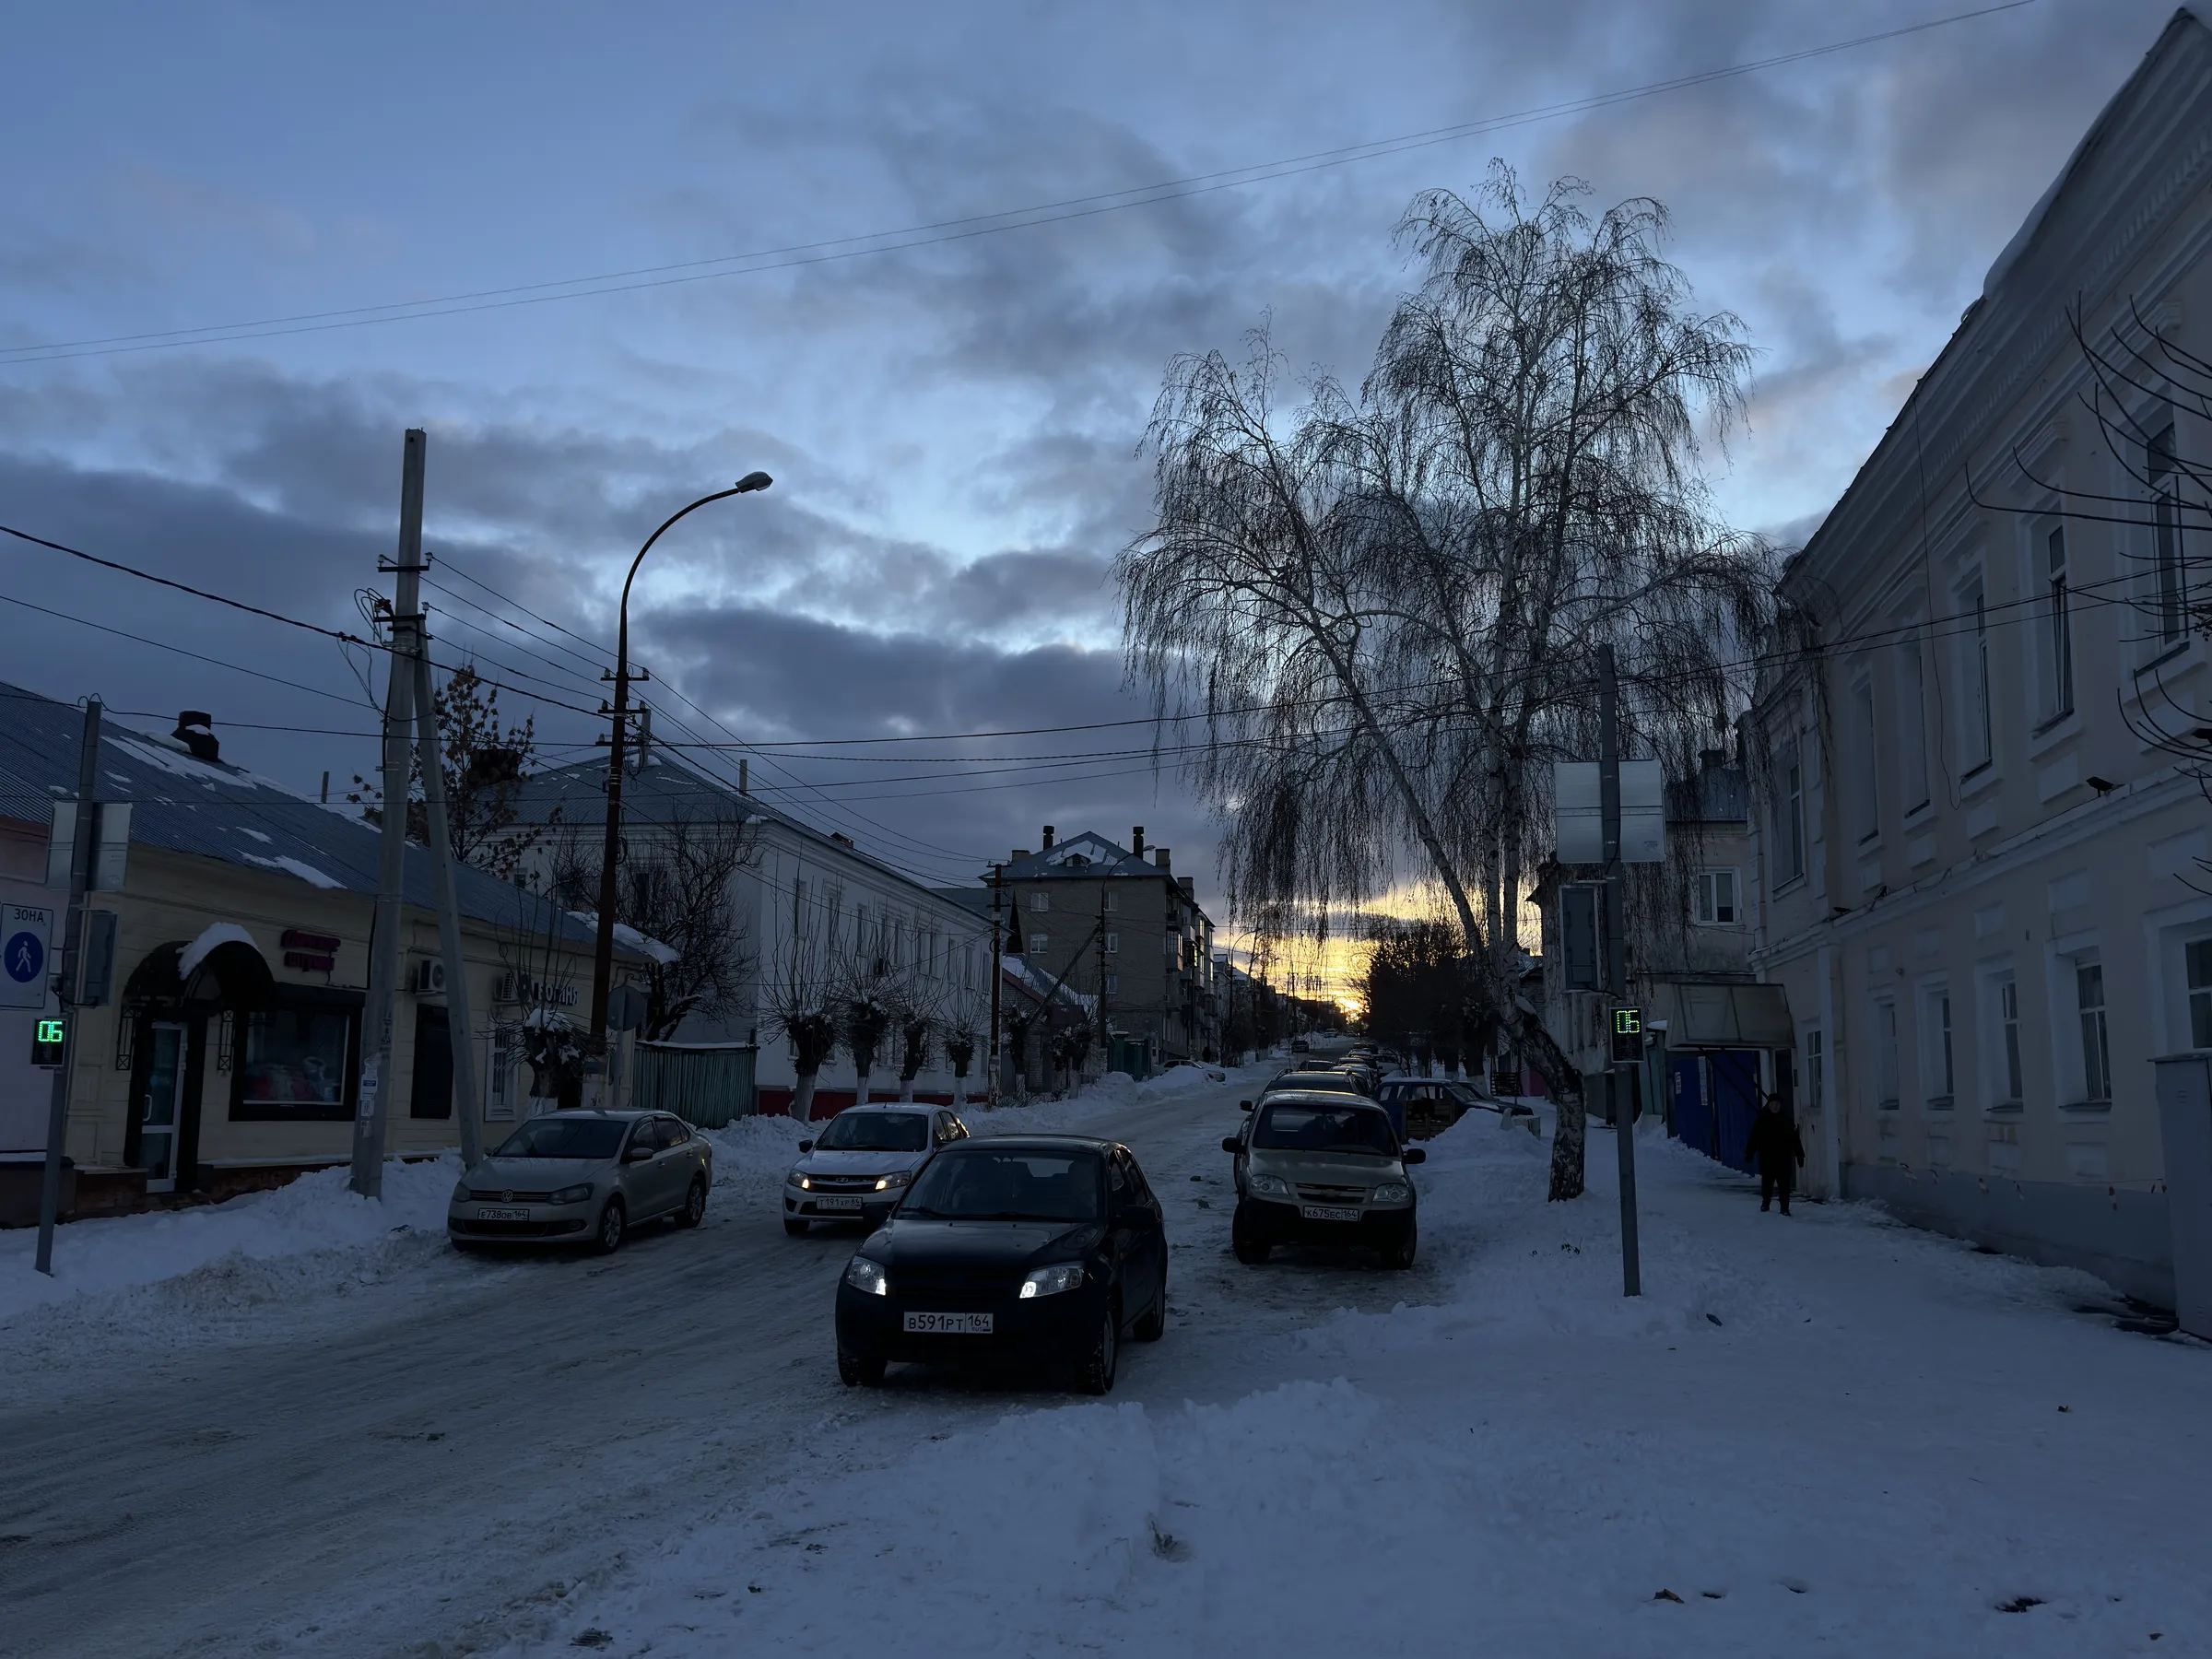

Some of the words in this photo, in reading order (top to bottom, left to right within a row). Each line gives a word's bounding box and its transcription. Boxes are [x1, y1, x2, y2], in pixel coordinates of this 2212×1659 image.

[14, 908, 44, 923] ЗОНА
[1617, 1009, 1640, 1033] 06
[38, 1020, 63, 1042] 06
[968, 1314, 989, 1327] 164
